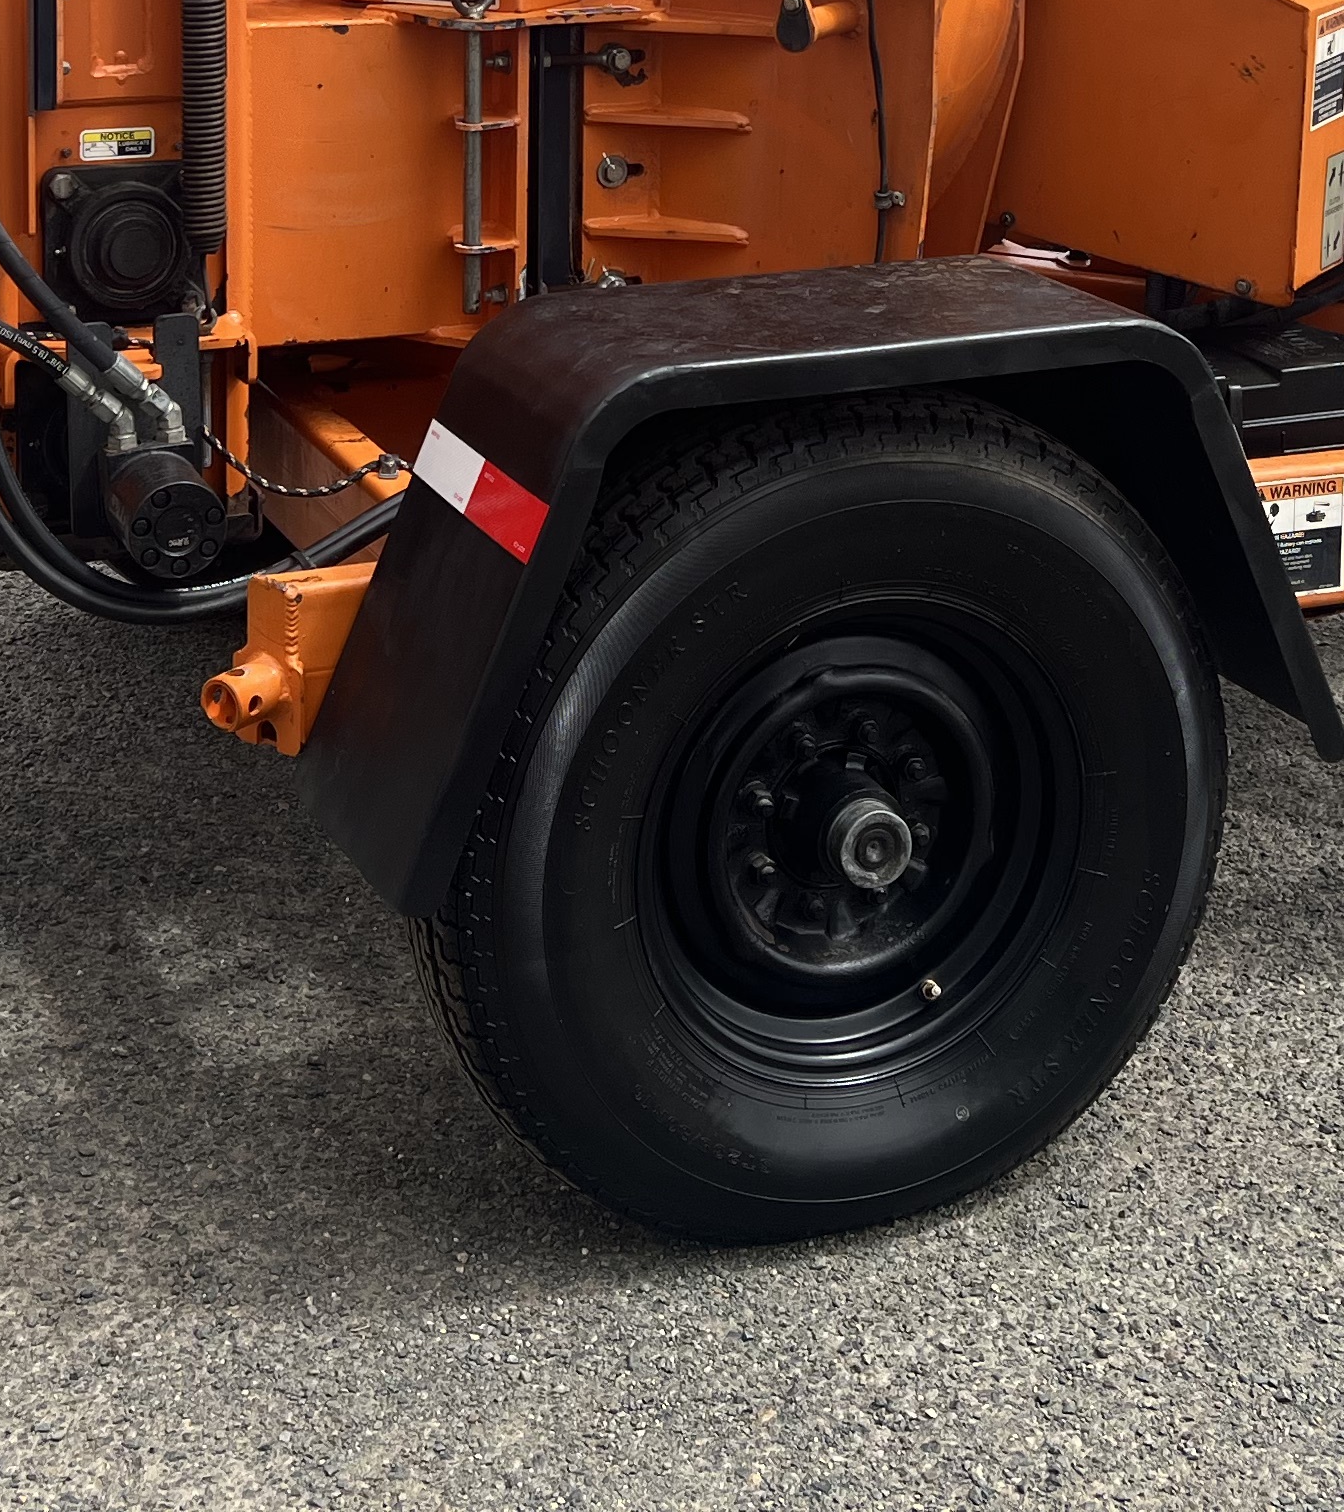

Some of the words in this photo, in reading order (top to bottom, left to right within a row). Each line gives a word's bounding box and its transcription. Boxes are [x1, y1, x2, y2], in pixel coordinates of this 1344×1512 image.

[100, 131, 135, 140] NOTICE
[1270, 480, 1337, 500] WARNING
[575, 634, 686, 831] SCHOONER
[692, 581, 749, 634] STR
[1063, 868, 1161, 1054] SCHOONER
[1007, 1052, 1060, 1105] STR
